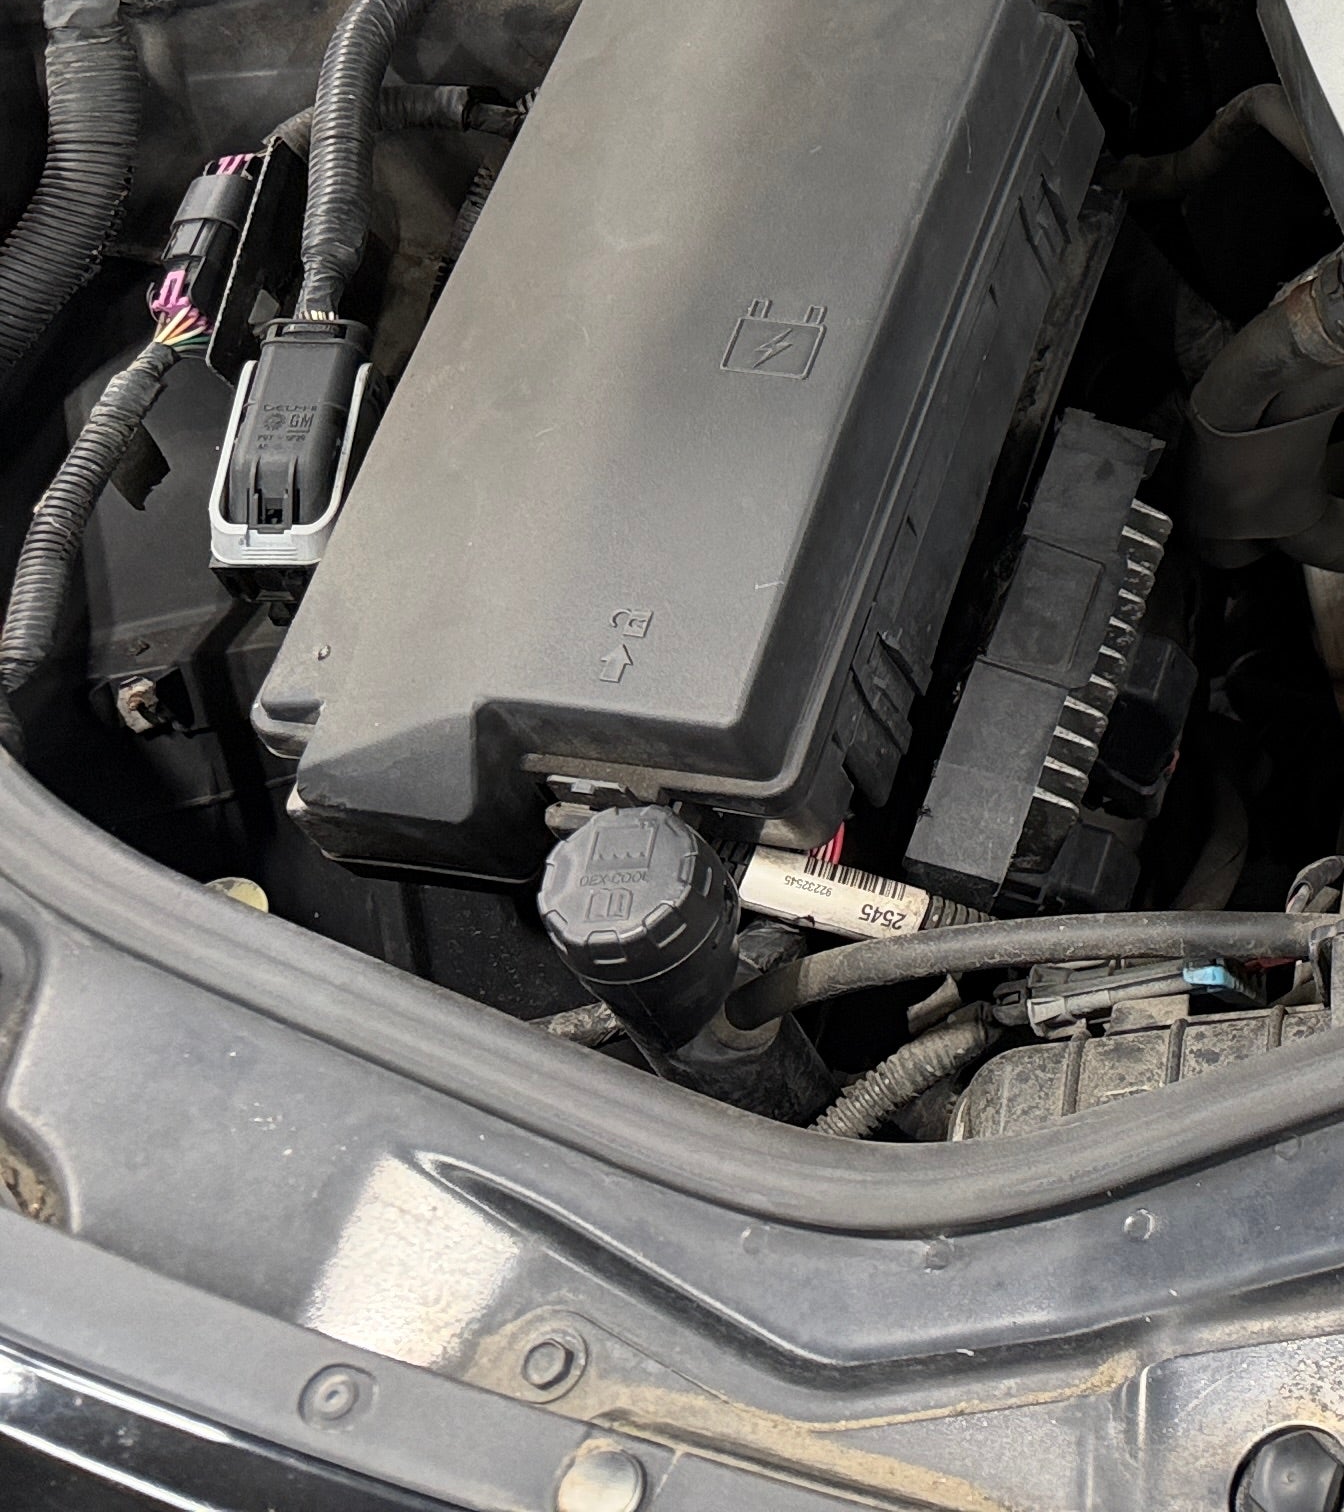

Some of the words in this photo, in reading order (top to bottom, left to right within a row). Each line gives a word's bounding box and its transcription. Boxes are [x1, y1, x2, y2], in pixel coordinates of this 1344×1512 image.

[290, 413, 315, 429] GM
[783, 875, 832, 897] 92232545
[858, 903, 908, 930] 2545
